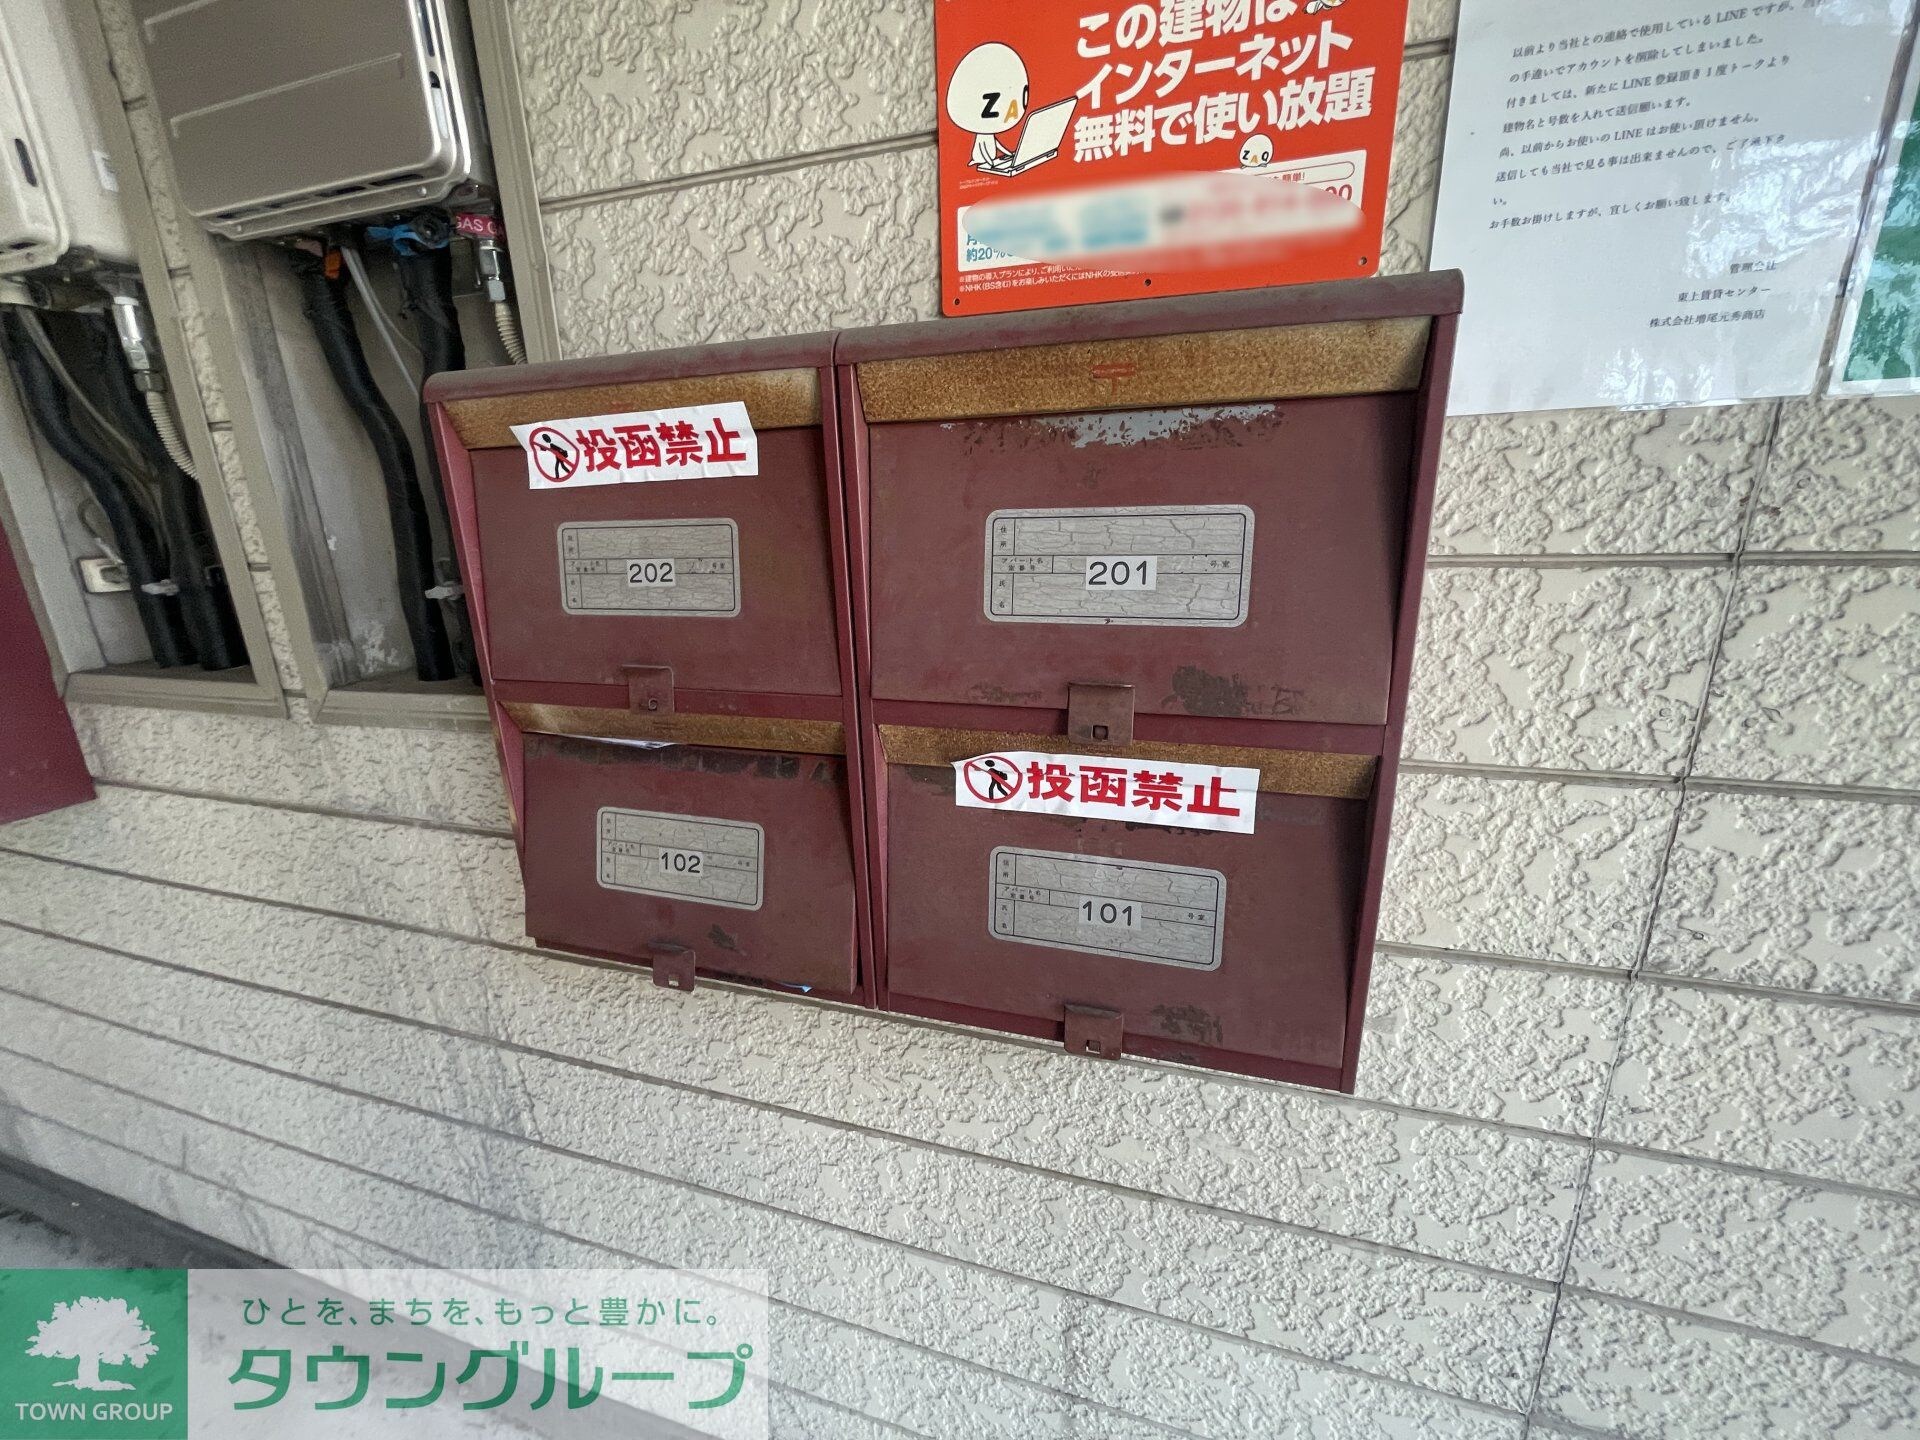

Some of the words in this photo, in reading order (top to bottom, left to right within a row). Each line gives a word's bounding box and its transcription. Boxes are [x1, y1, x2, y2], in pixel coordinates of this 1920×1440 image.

[1512, 0, 1824, 58] 以前より当社との連絡で使用しているLINEですが、
[1077, 20, 1353, 109] インターネット
[1073, 67, 1376, 163] 無料で使い放題
[1503, 97, 1690, 134] 建物名と号数を入れて送信願います。
[1242, 150, 1270, 164] ZAQ
[1729, 261, 1777, 275] 管理会社
[1678, 286, 1771, 303] 東上賃貸センター
[576, 418, 747, 473] 投函禁止
[629, 562, 674, 583] 202
[1088, 560, 1149, 586] 201
[1026, 761, 1241, 817] 投函禁止
[661, 852, 701, 874] 102
[1082, 901, 1133, 927] 101
